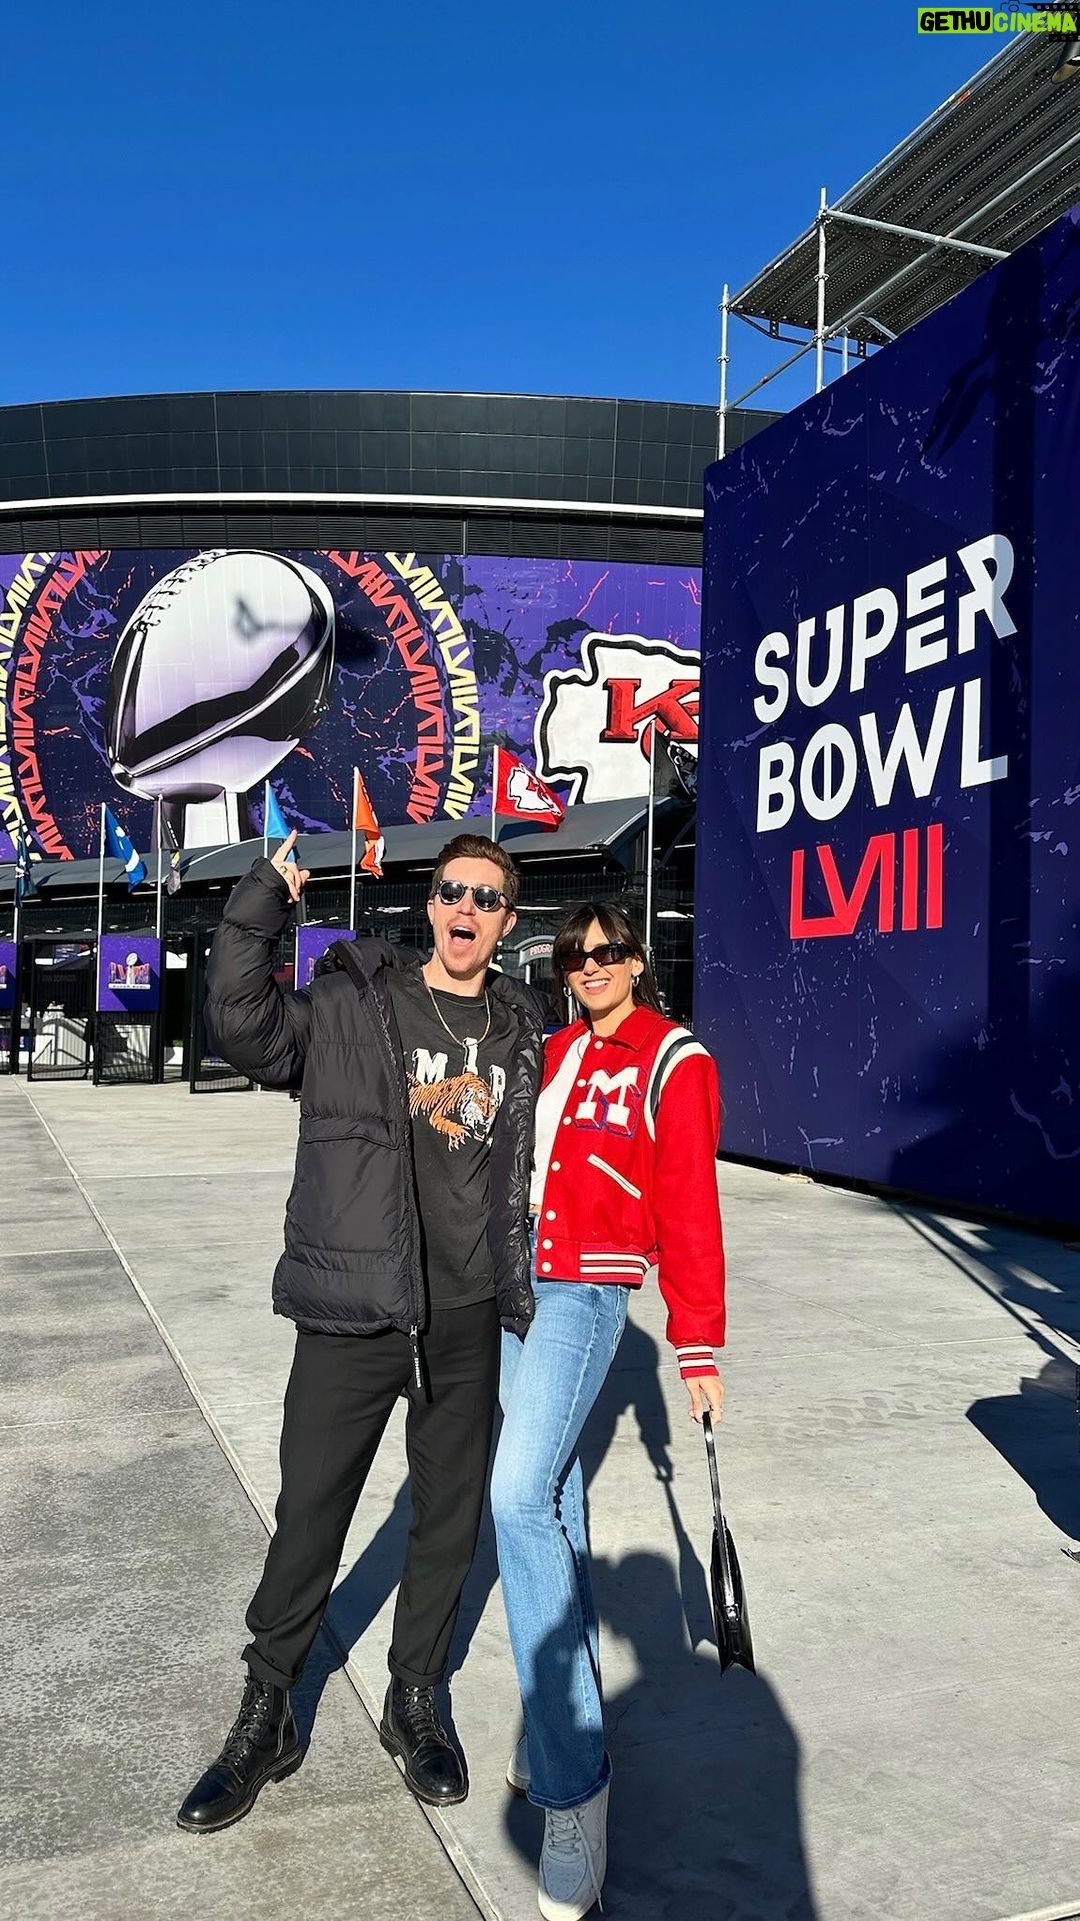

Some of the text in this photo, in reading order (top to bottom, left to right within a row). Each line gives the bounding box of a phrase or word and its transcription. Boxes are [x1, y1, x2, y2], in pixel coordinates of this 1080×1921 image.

[753, 534, 1018, 724] SUPER
[756, 677, 1008, 833] BOWL
[575, 1064, 647, 1139] M
